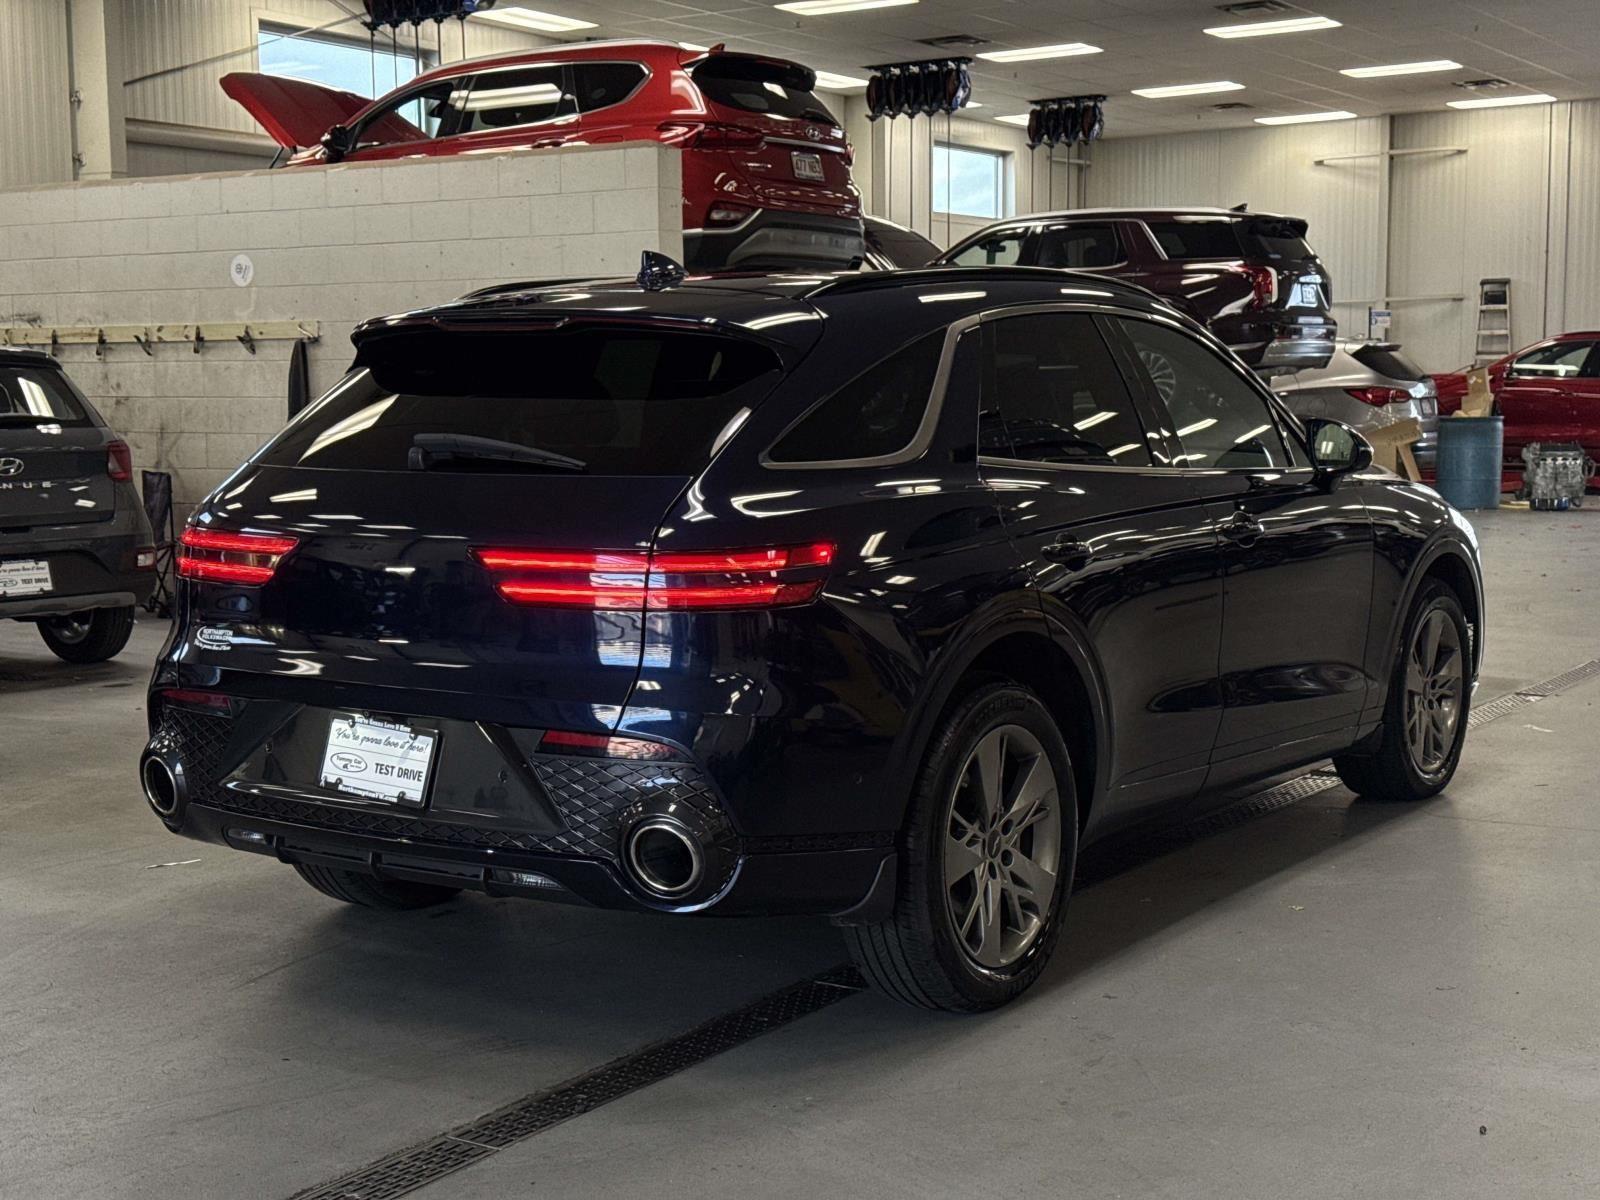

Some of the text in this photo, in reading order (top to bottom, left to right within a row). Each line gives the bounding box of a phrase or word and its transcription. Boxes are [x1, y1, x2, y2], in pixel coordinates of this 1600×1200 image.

[0, 481, 52, 489] NUE
[335, 727, 359, 740] You're
[359, 735, 382, 746] gonna
[383, 736, 398, 749] love
[374, 763, 423, 782] TEST DRIVE
